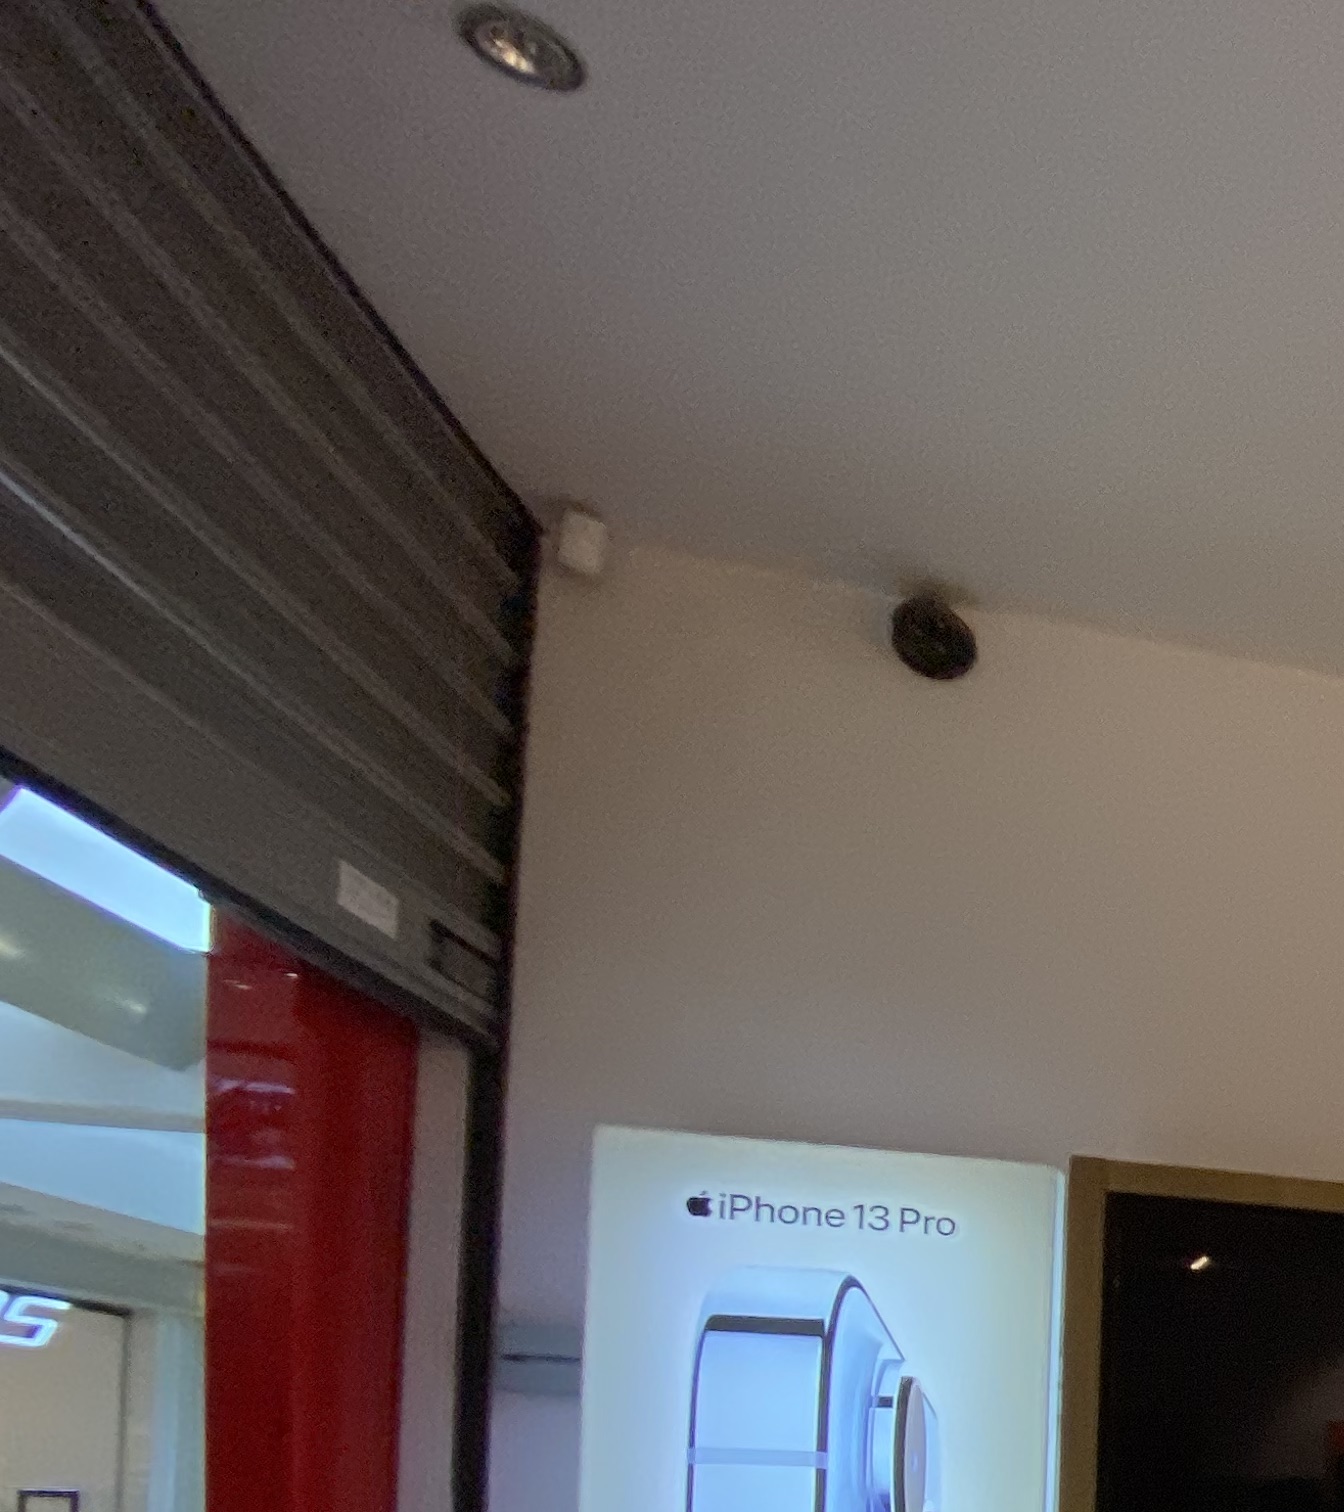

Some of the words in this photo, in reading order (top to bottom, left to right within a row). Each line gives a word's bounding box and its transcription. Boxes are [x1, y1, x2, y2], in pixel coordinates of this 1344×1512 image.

[718, 1193, 846, 1228] iPhone
[853, 1203, 890, 1231] 13
[899, 1206, 957, 1236] Pro
